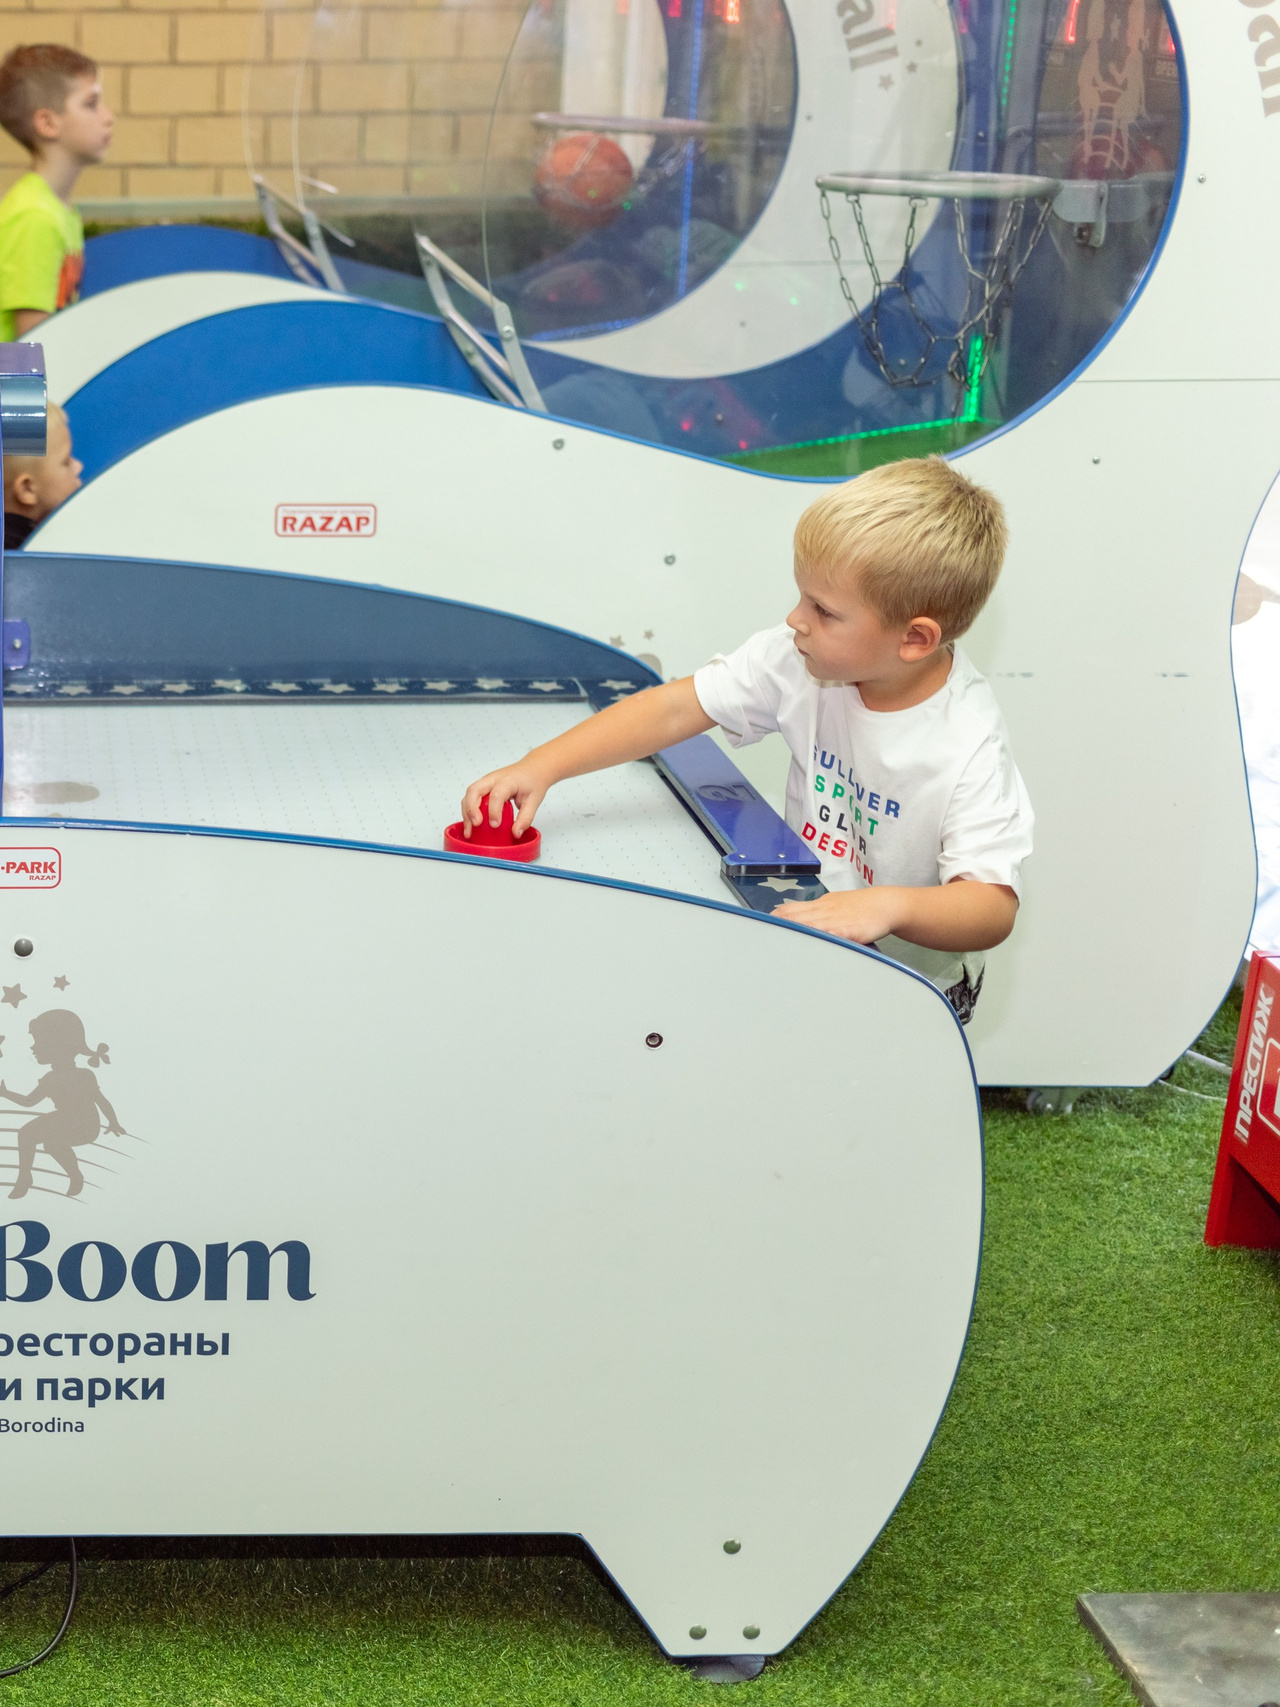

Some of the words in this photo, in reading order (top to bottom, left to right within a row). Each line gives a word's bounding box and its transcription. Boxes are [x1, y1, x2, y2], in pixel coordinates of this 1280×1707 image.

[281, 515, 370, 532] RAZAP
[801, 821, 875, 886] DESIGN
[1235, 983, 1274, 1141] ПРЕСТИЖ
[36, 1375, 166, 1408] парки
